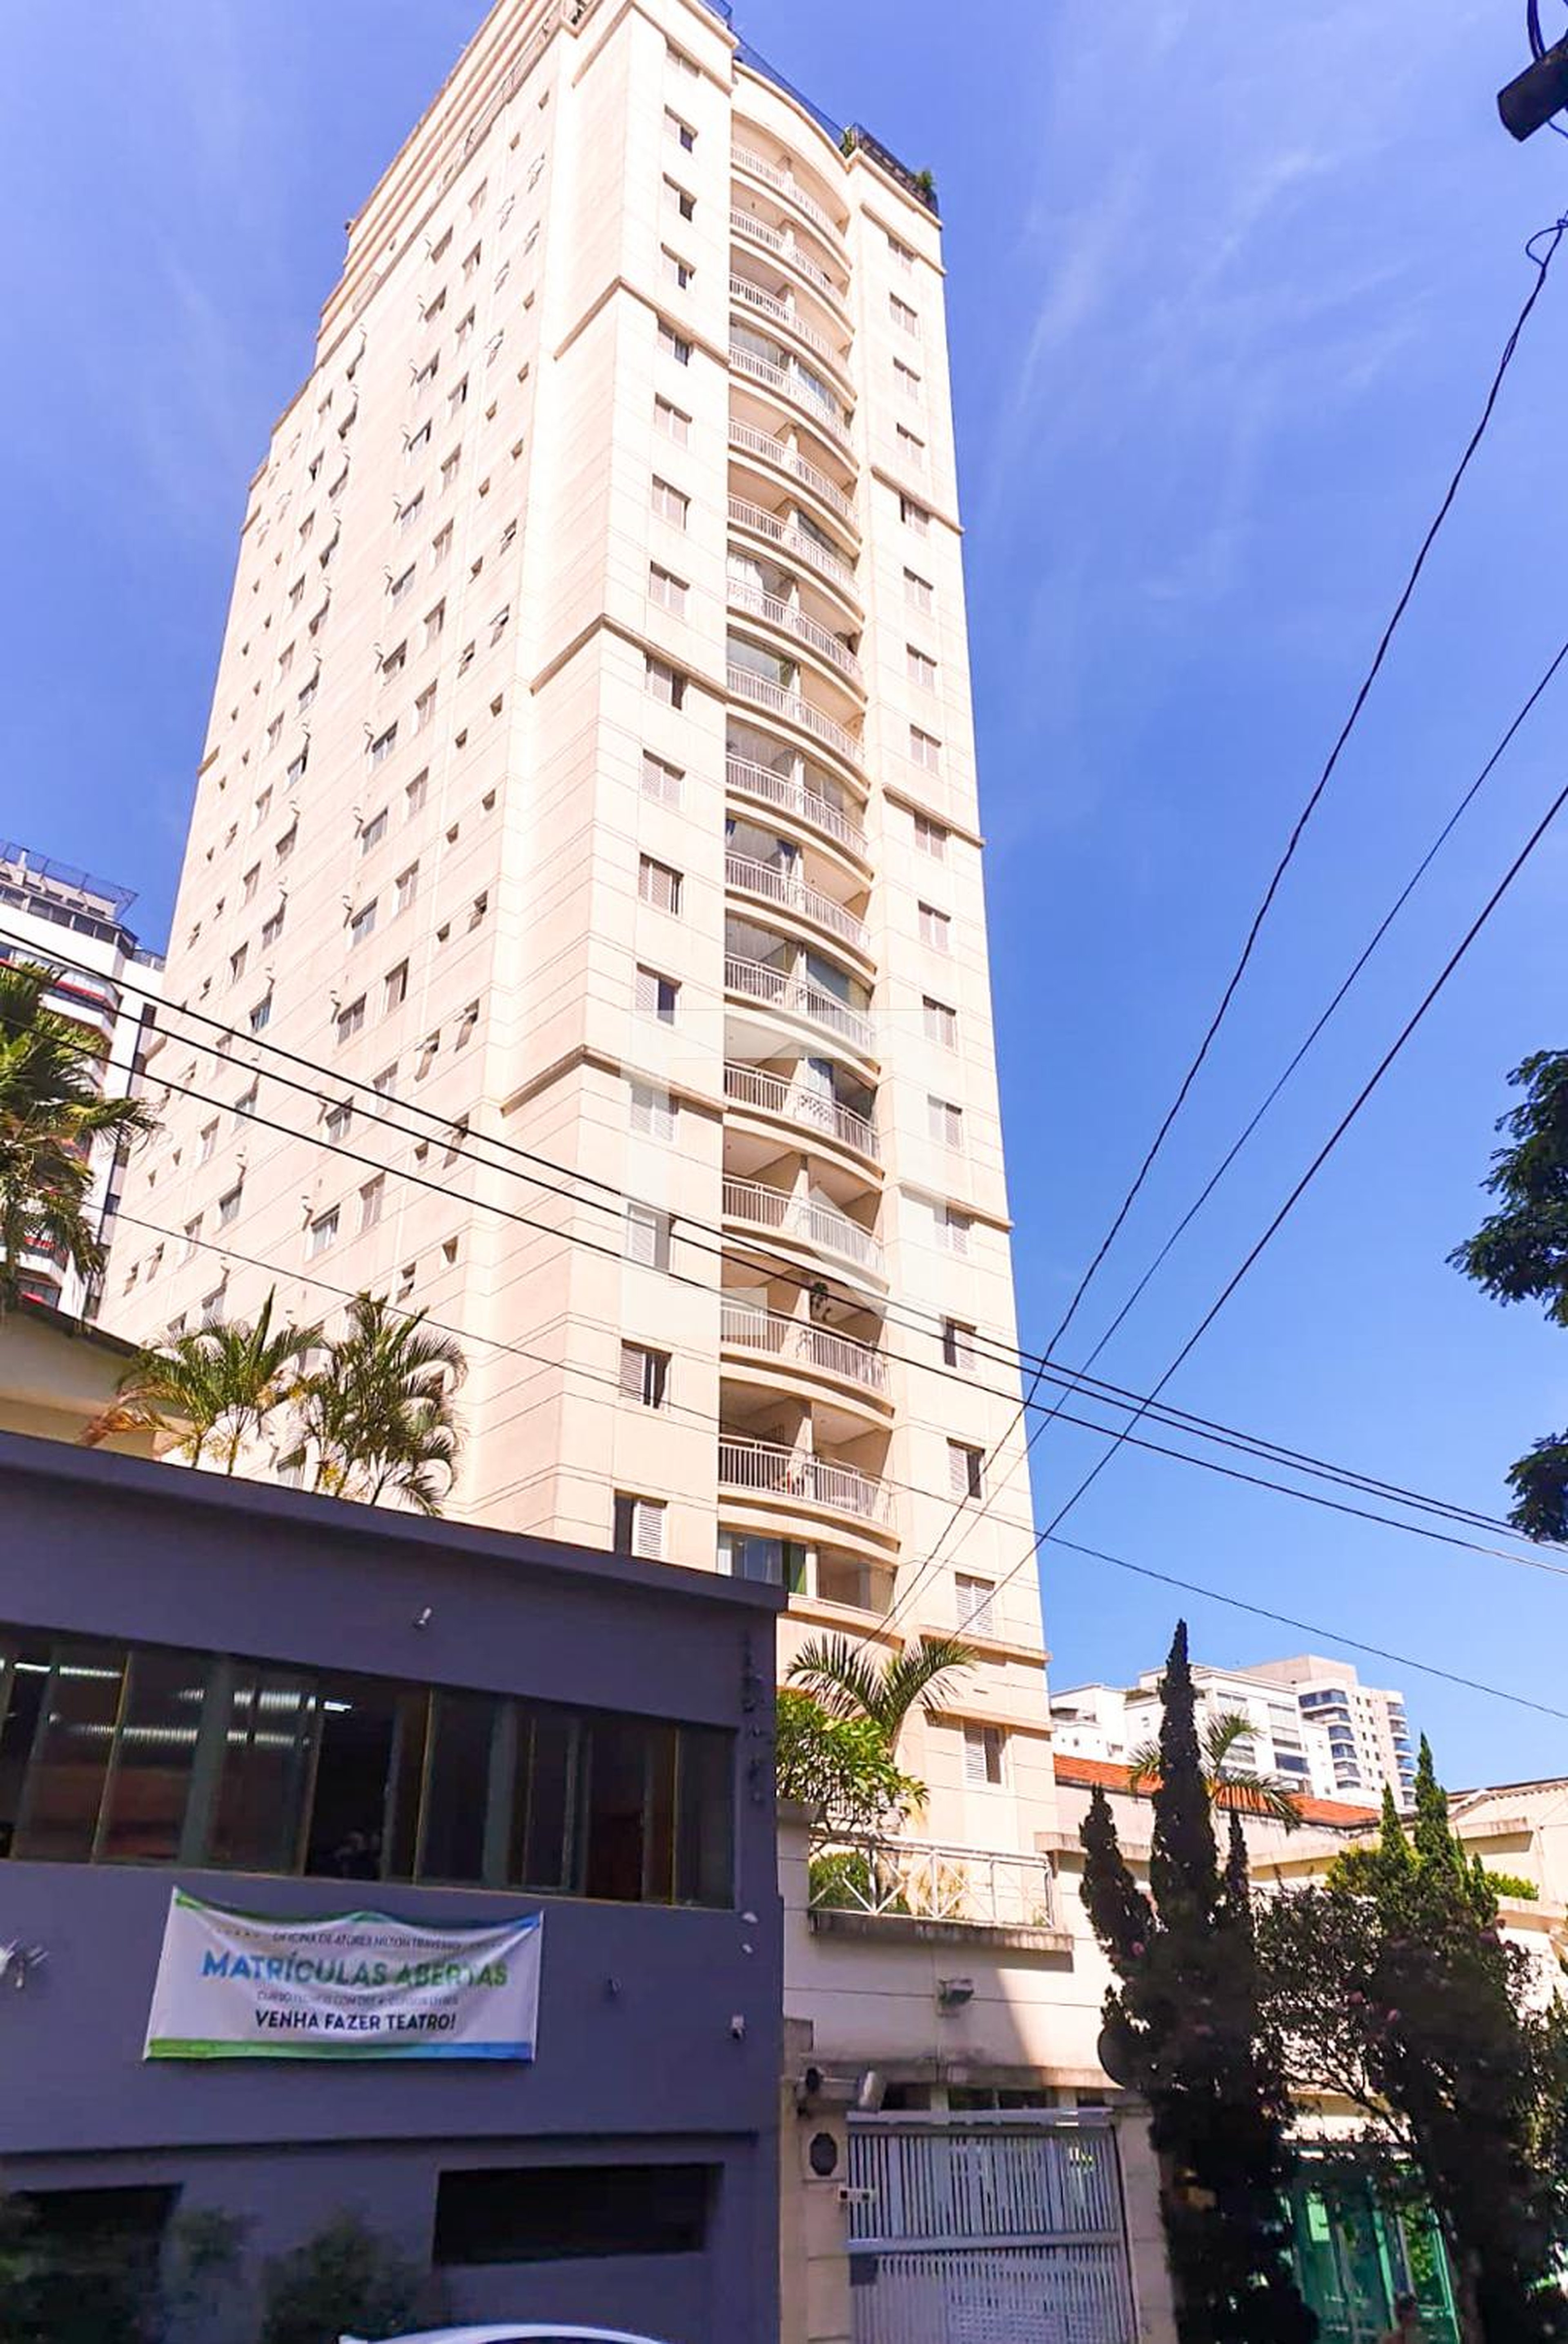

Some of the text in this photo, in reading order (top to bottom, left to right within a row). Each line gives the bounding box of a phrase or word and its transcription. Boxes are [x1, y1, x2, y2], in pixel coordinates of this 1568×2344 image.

[202, 1950, 386, 1986] MATRÍCULAS
[255, 2009, 456, 2030] VENHA FAZER TEATRO!
